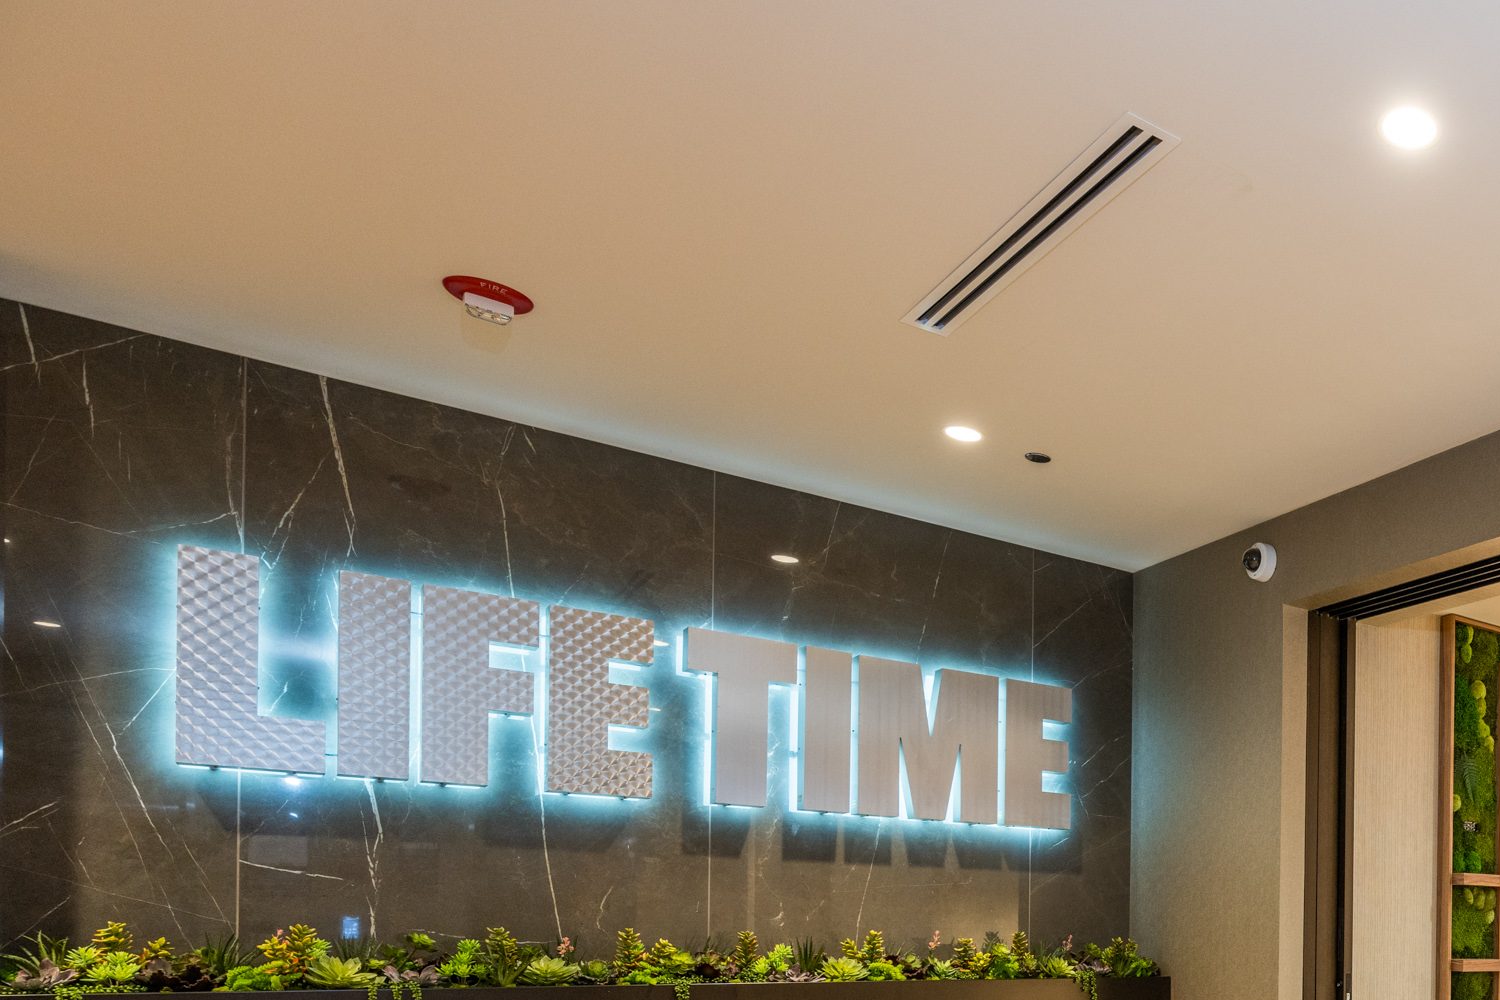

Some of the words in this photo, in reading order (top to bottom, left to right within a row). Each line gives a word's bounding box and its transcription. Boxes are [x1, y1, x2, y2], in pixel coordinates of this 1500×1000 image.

[480, 281, 508, 296] FIRE
[175, 543, 655, 799] LIFE
[682, 626, 1073, 830] TIME
